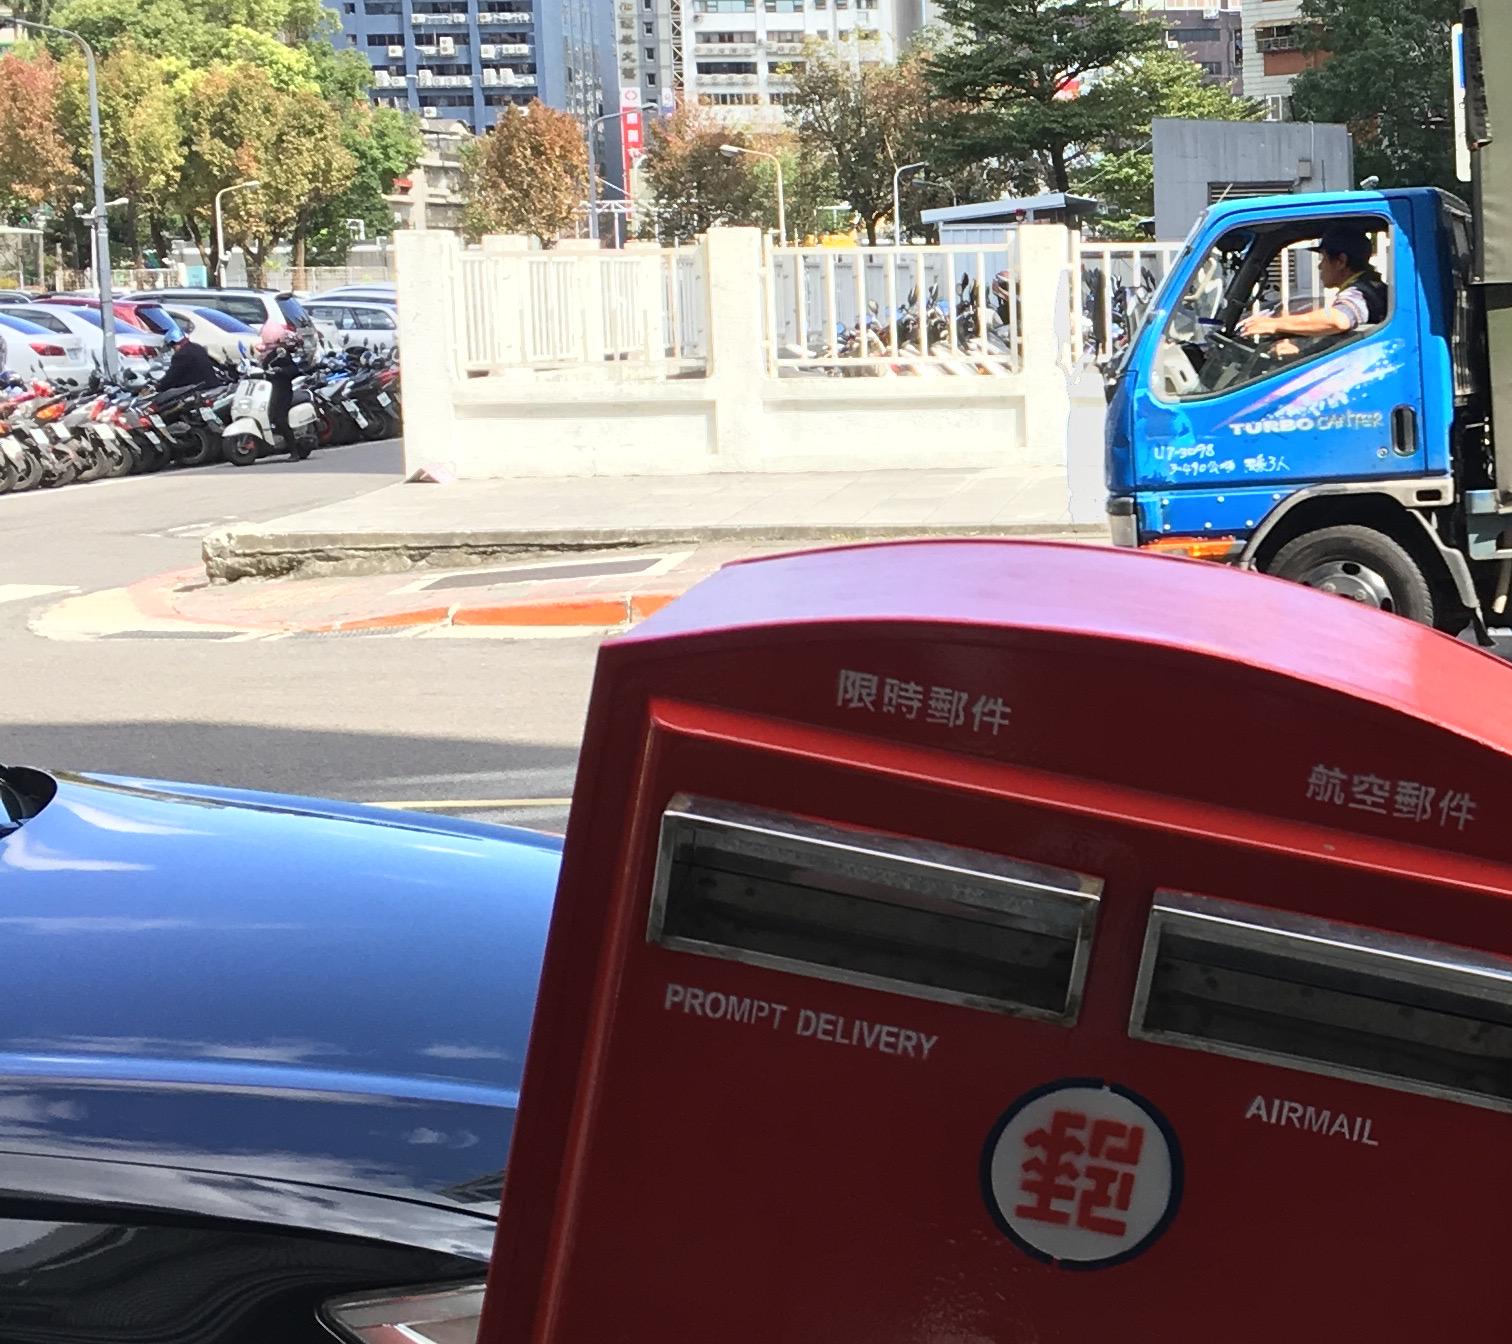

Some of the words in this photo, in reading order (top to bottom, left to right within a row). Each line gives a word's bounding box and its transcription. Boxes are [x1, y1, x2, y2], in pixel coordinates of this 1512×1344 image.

[1229, 418, 1314, 435] TURBO
[836, 668, 1013, 736] 限時郵件
[1305, 763, 1478, 832] 航空郵件
[664, 983, 788, 1031] PROMPT
[796, 1007, 938, 1060] DELIVERY
[1245, 1094, 1380, 1147] AIRMAIL
[1014, 1109, 1146, 1238] 郵
